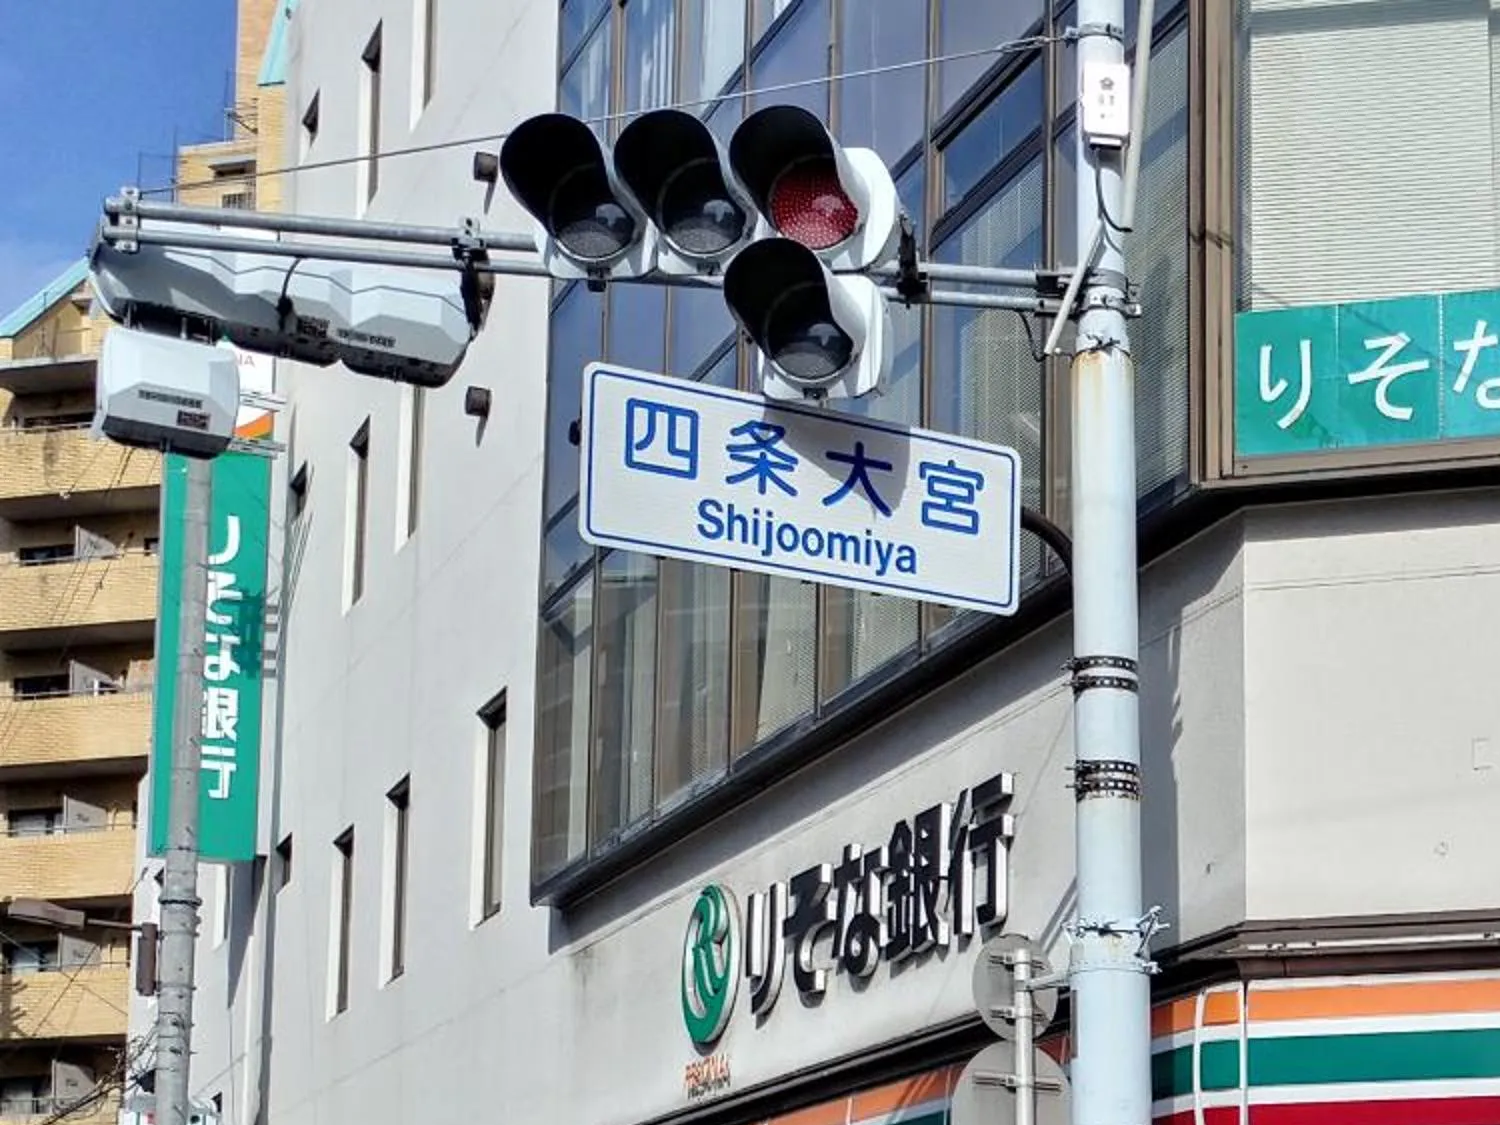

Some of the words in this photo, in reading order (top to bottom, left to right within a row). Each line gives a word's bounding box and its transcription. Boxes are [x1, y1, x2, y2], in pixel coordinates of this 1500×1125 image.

[624, 396, 985, 536] 四条大宮
[696, 498, 919, 576] Shijoomiya
[745, 772, 1015, 1016] りそな銀行
